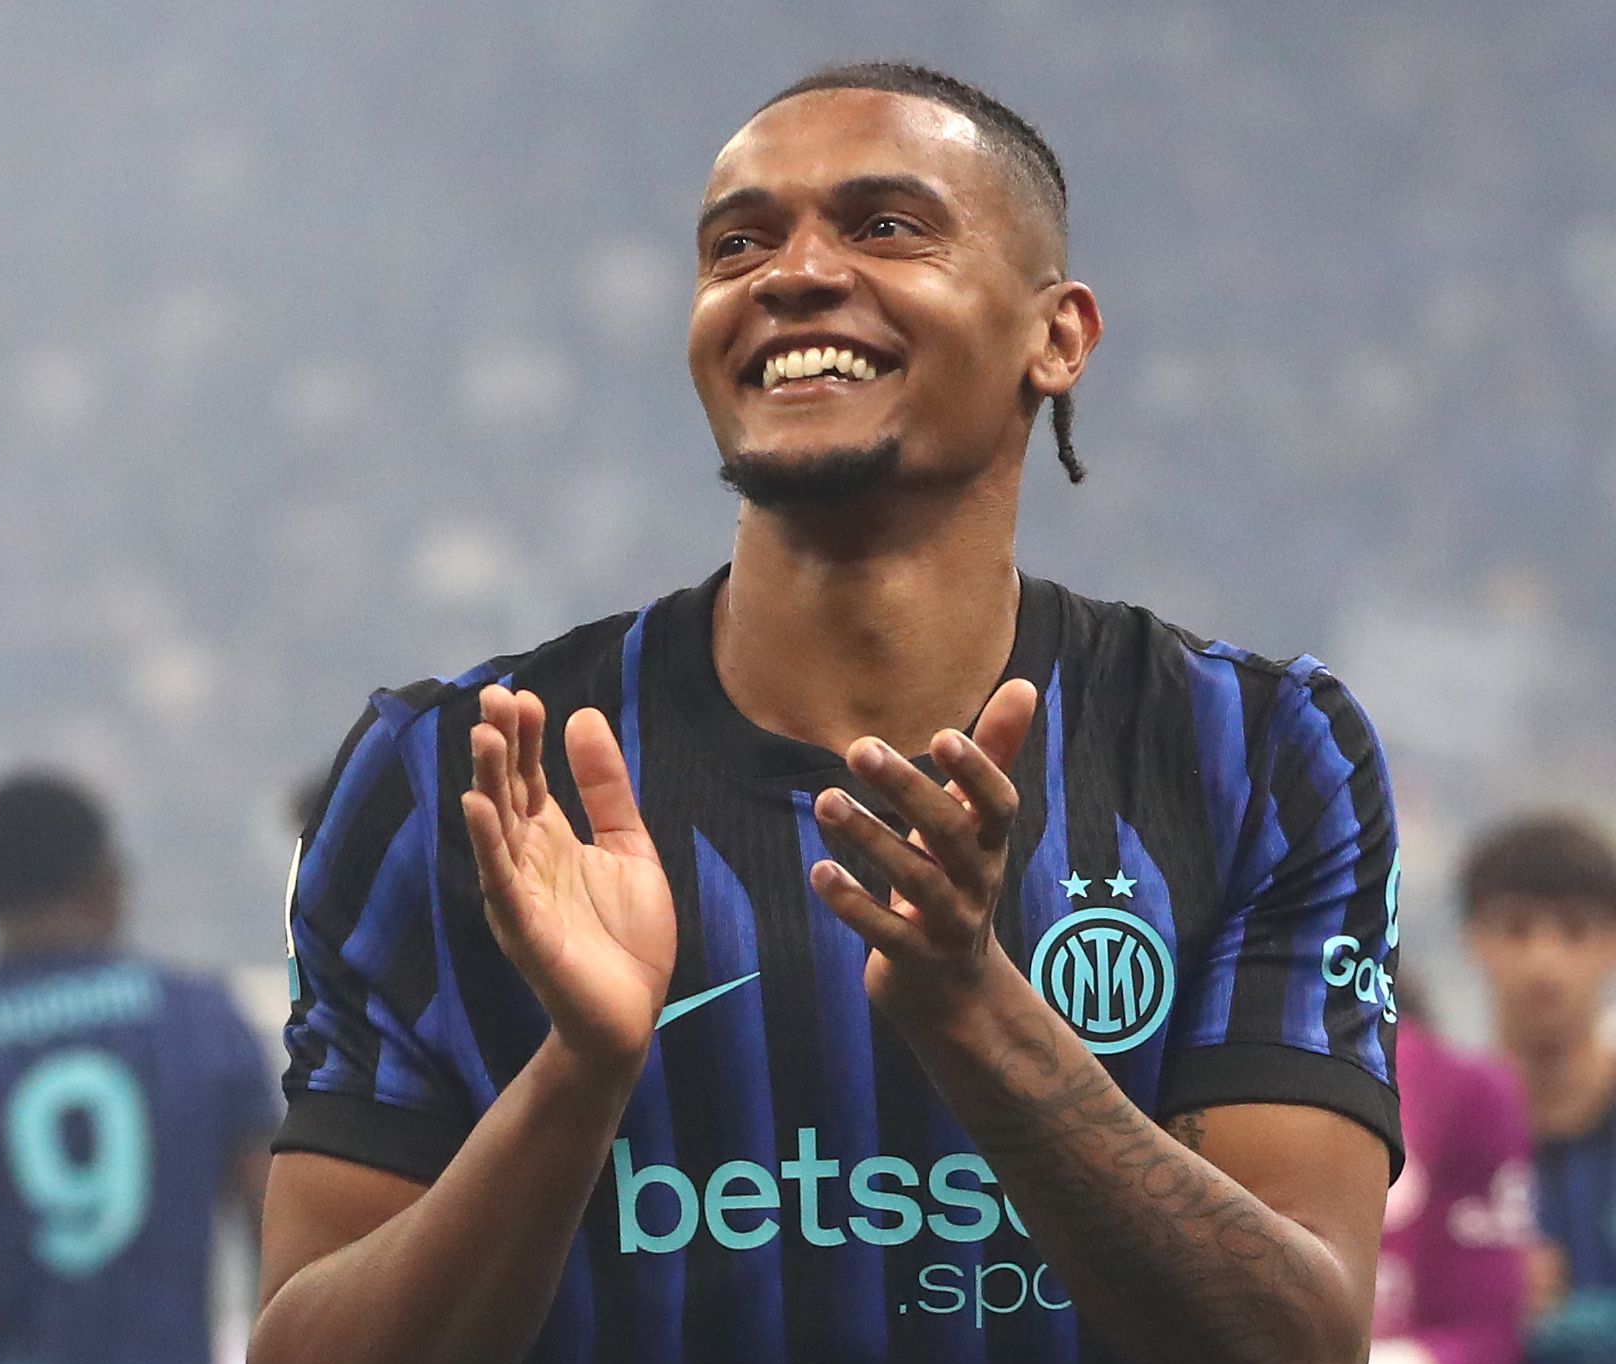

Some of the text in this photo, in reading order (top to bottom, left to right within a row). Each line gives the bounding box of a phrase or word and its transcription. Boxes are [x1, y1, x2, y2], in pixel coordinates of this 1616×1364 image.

[1, 1046, 154, 1280] 9
[611, 1127, 1031, 1255] betss
[898, 1261, 1074, 1330] .spo
